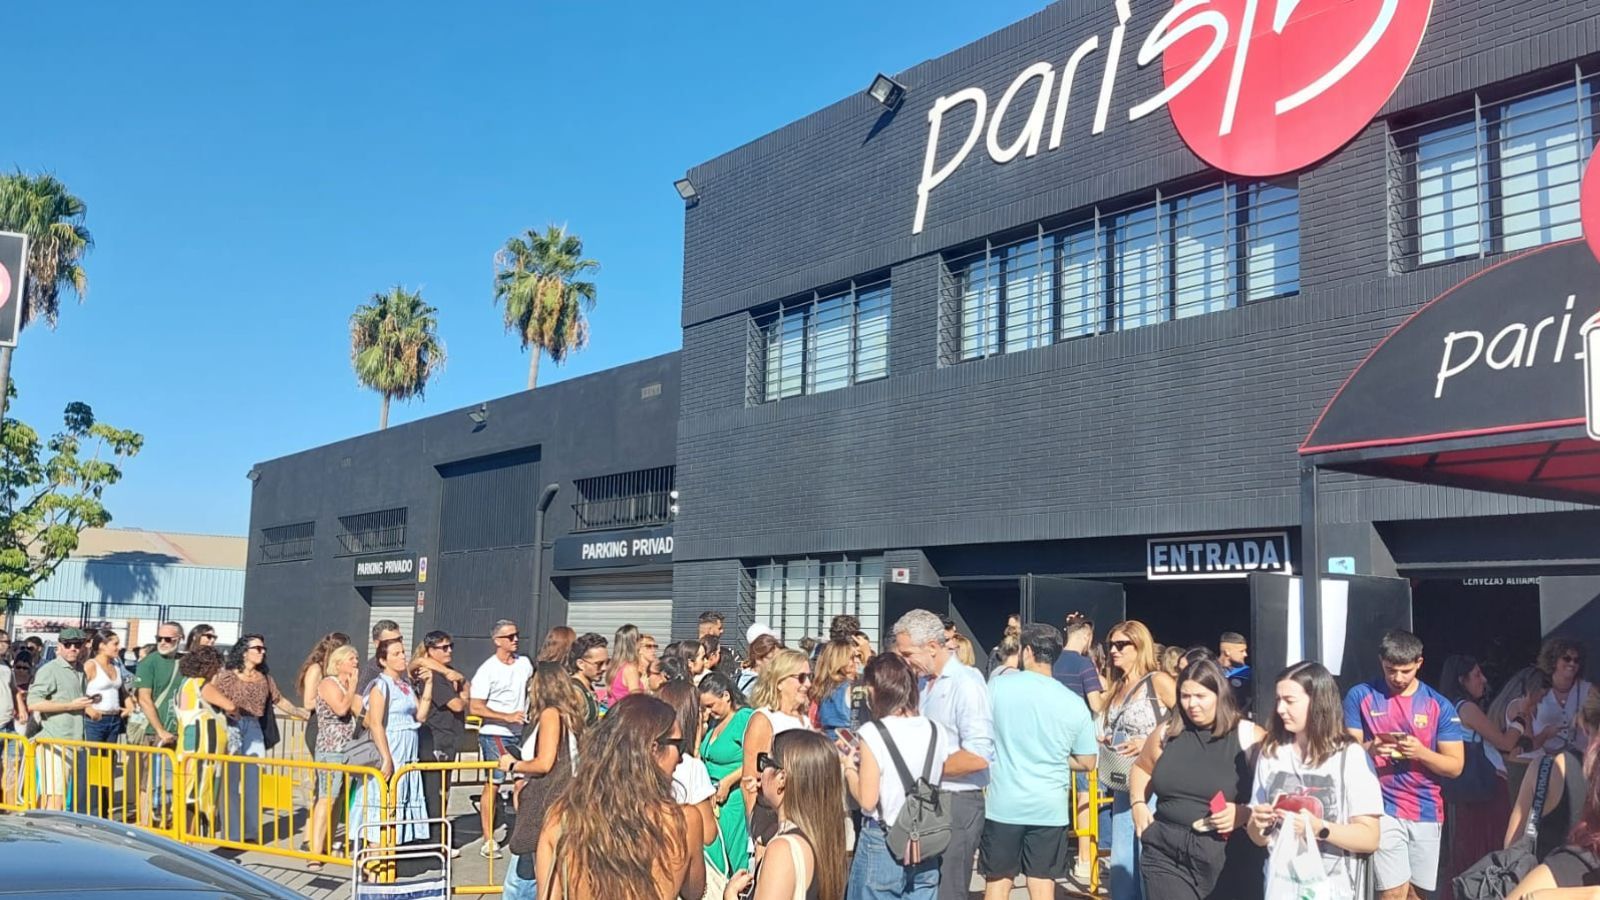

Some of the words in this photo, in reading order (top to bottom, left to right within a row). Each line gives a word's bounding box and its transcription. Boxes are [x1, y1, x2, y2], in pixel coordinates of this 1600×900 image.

[582, 540, 628, 560] PARKING
[1154, 540, 1281, 573] ENTRADA
[357, 561, 384, 575] PARKING
[384, 559, 412, 573] PRIVADO
